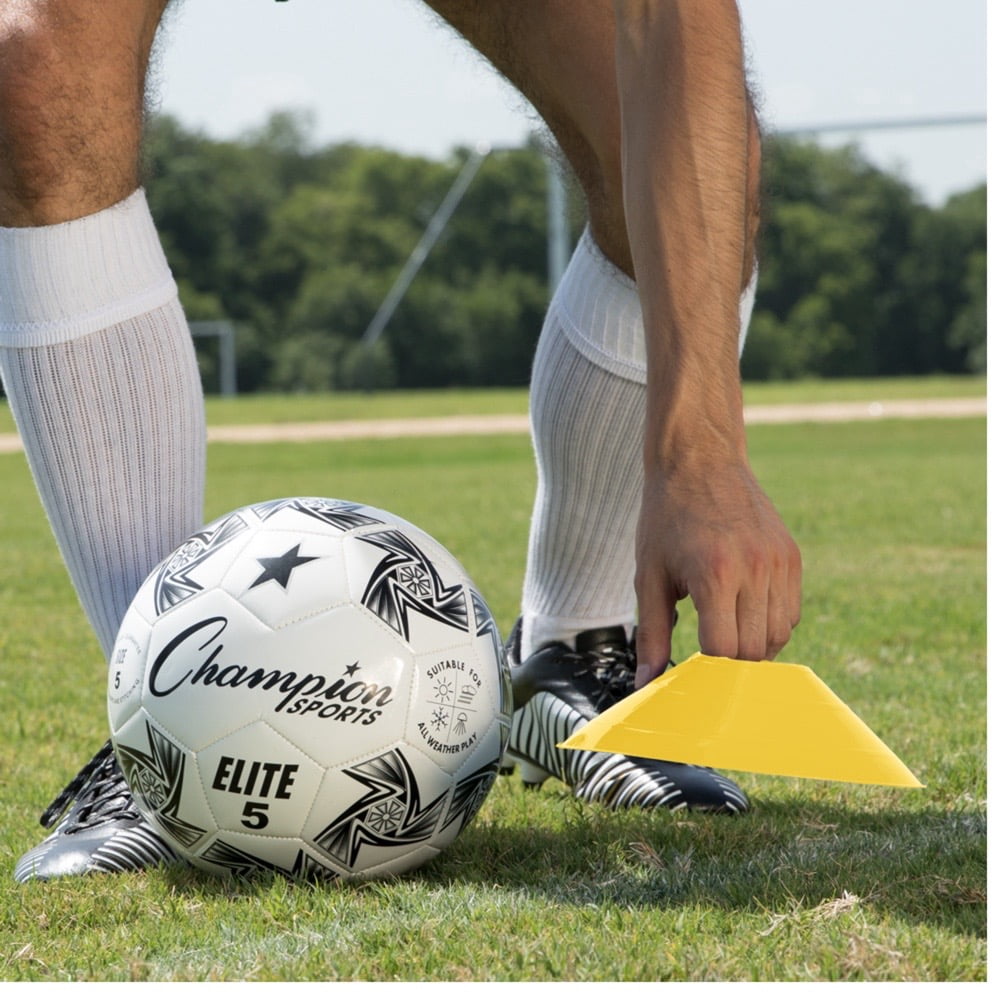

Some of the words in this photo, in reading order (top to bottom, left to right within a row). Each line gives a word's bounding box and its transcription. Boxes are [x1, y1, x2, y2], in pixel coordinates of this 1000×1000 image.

[149, 616, 393, 712] Champion
[426, 660, 465, 679] SUITABLE
[468, 668, 482, 688] FOR
[114, 671, 121, 690] 5
[286, 698, 382, 725] SPORTS
[417, 722, 430, 740] ALL
[426, 735, 460, 754] WEATHER
[461, 731, 477, 751] PLAY
[211, 755, 299, 800] ELITE
[240, 801, 269, 829] 5
